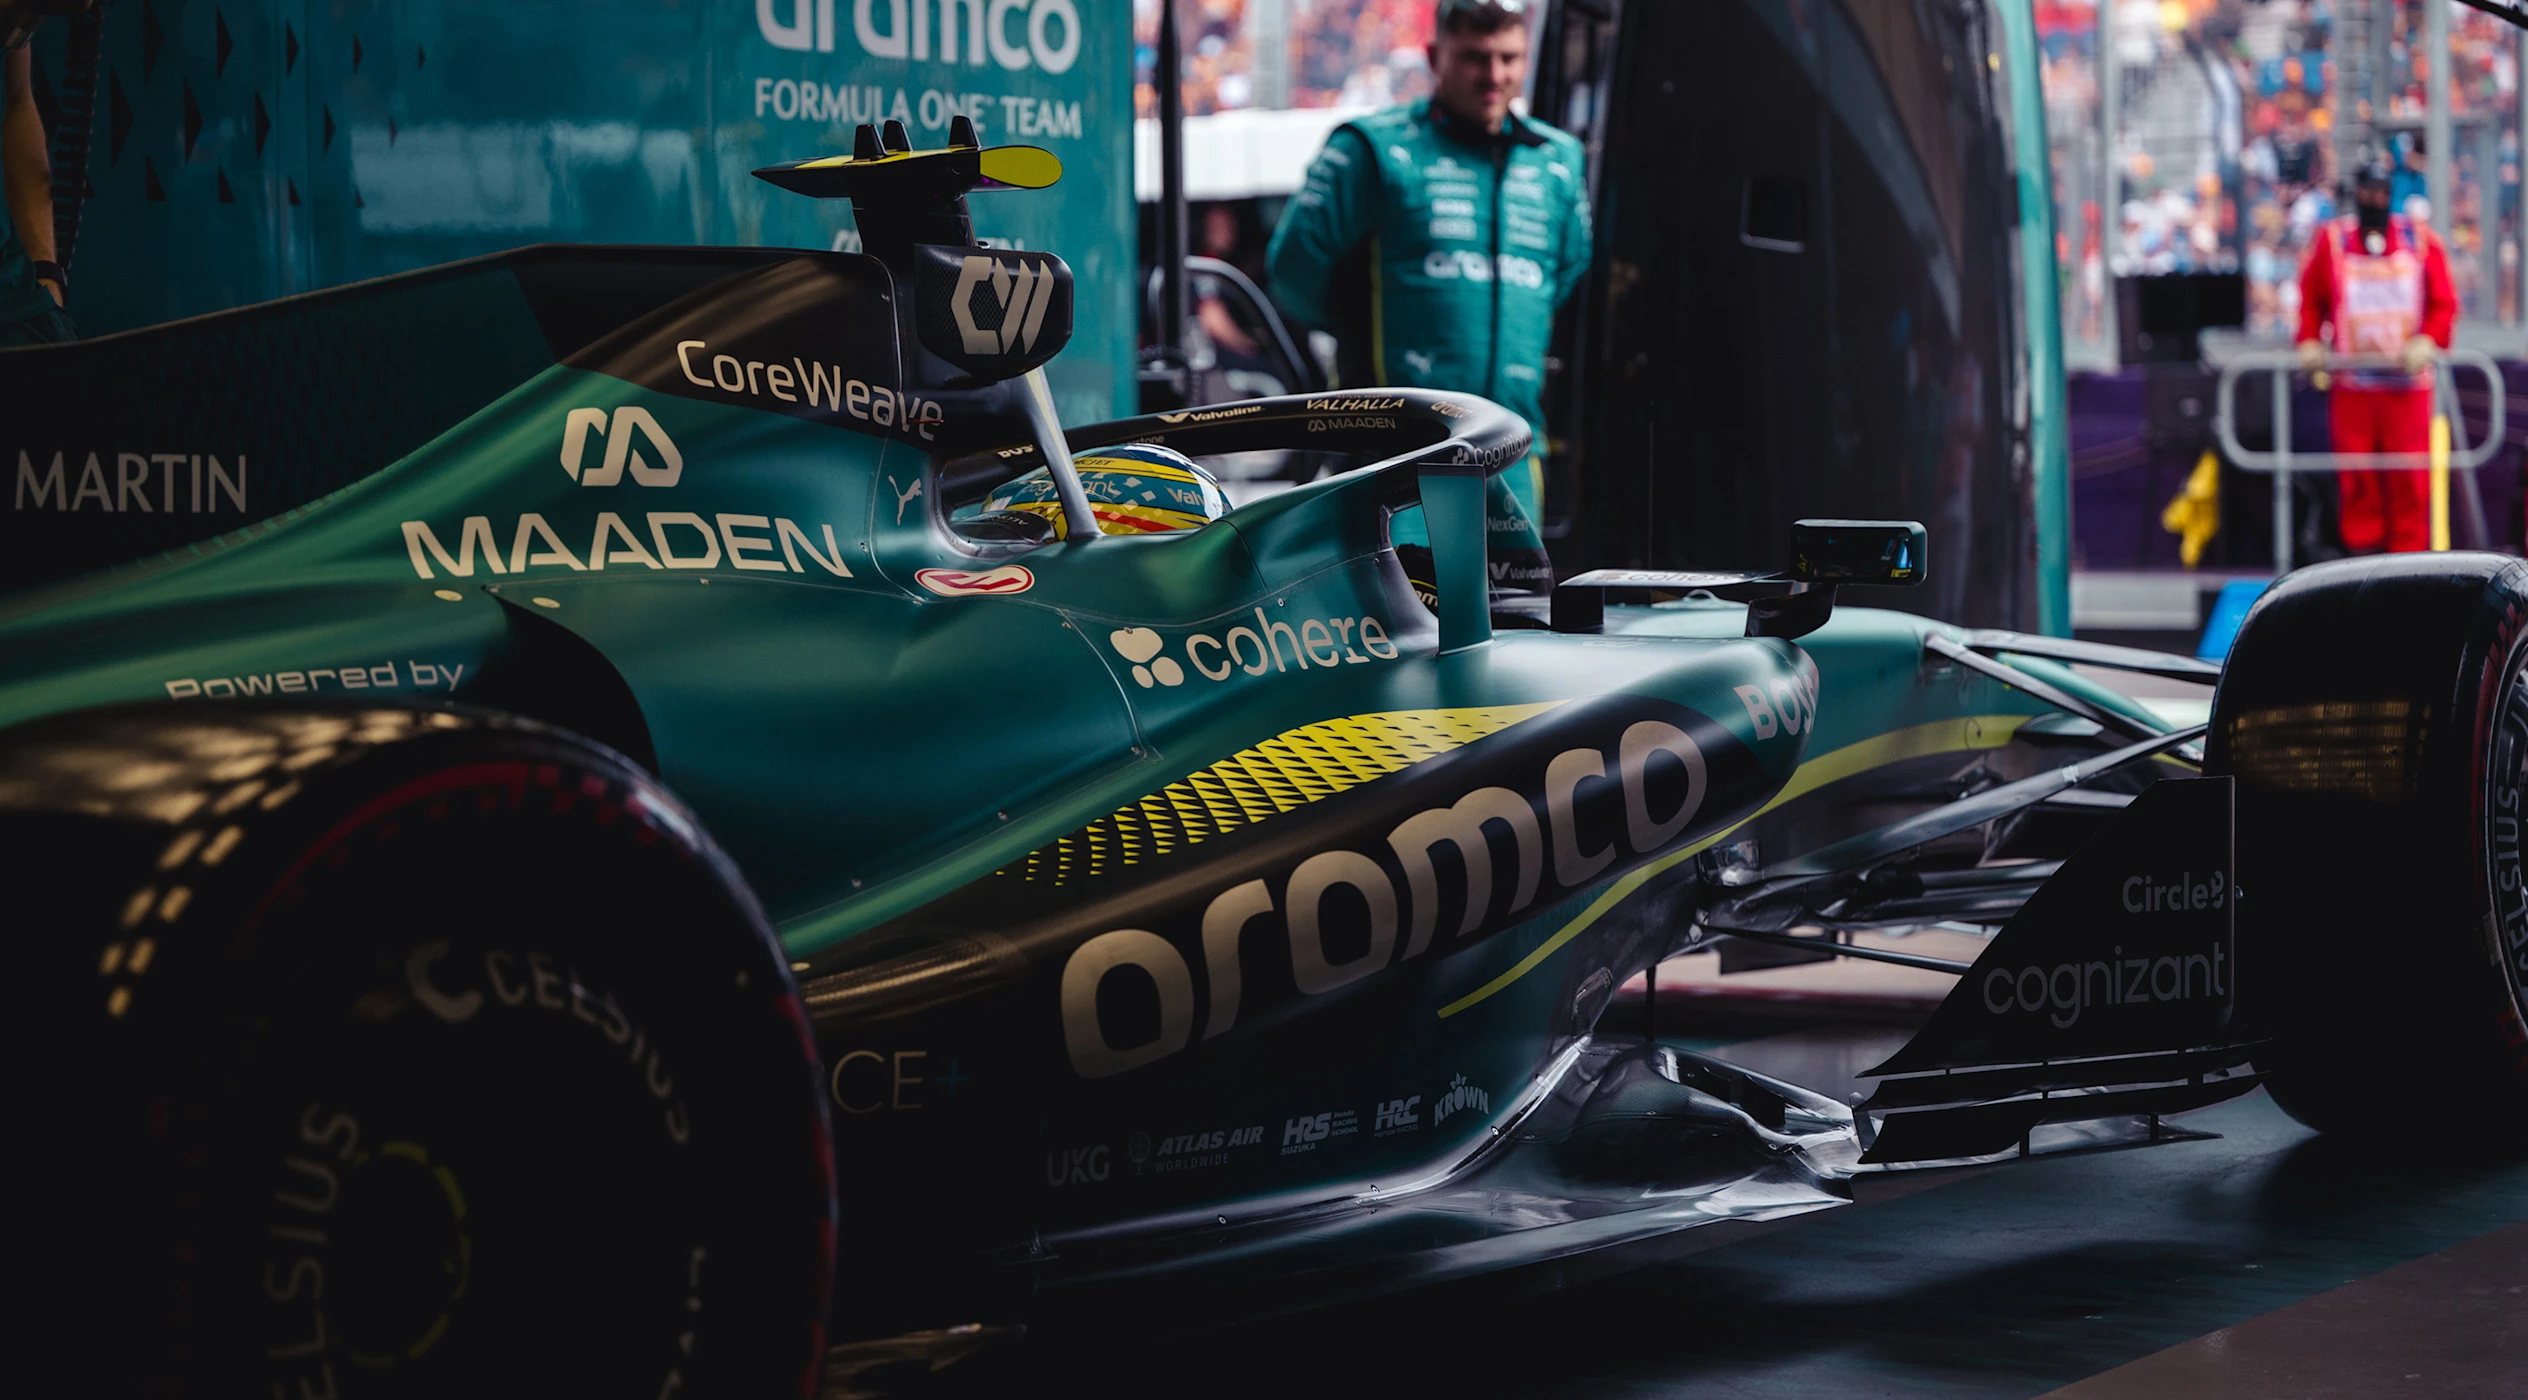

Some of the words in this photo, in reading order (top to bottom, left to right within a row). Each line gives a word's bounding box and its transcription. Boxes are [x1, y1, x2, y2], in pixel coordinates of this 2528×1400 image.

[756, 0, 1081, 74] aramco
[755, 78, 911, 126] FORMULA
[1004, 97, 1081, 140] TEAM
[677, 340, 943, 441] CoreWeave
[1306, 398, 1405, 411] VALHALLA
[1190, 405, 1262, 422] Valvoline
[1329, 417, 1396, 429] MAADEN
[1473, 434, 1527, 468] Cognition
[15, 449, 246, 513] MARTIN
[1487, 516, 1530, 532] NexGen
[401, 512, 854, 579] MAADEN
[1186, 607, 1399, 683] cohere
[165, 661, 398, 700] Powered
[408, 660, 464, 692] by
[1060, 720, 1707, 1079] aramco
[1983, 942, 2226, 1029] cognizant
[1374, 1095, 1422, 1130] HRC
[1433, 1085, 1490, 1127] KROWN
[1156, 1130, 1226, 1156] ATLAS
[1227, 1125, 1265, 1148] AIR
[1280, 1143, 1316, 1156] SUZUKA
[1281, 1112, 1332, 1146] HRS
[1046, 1144, 1111, 1188] UKG
[1155, 1152, 1229, 1173] WORLDWIDE
[261, 1102, 360, 1400] ELSIUS
